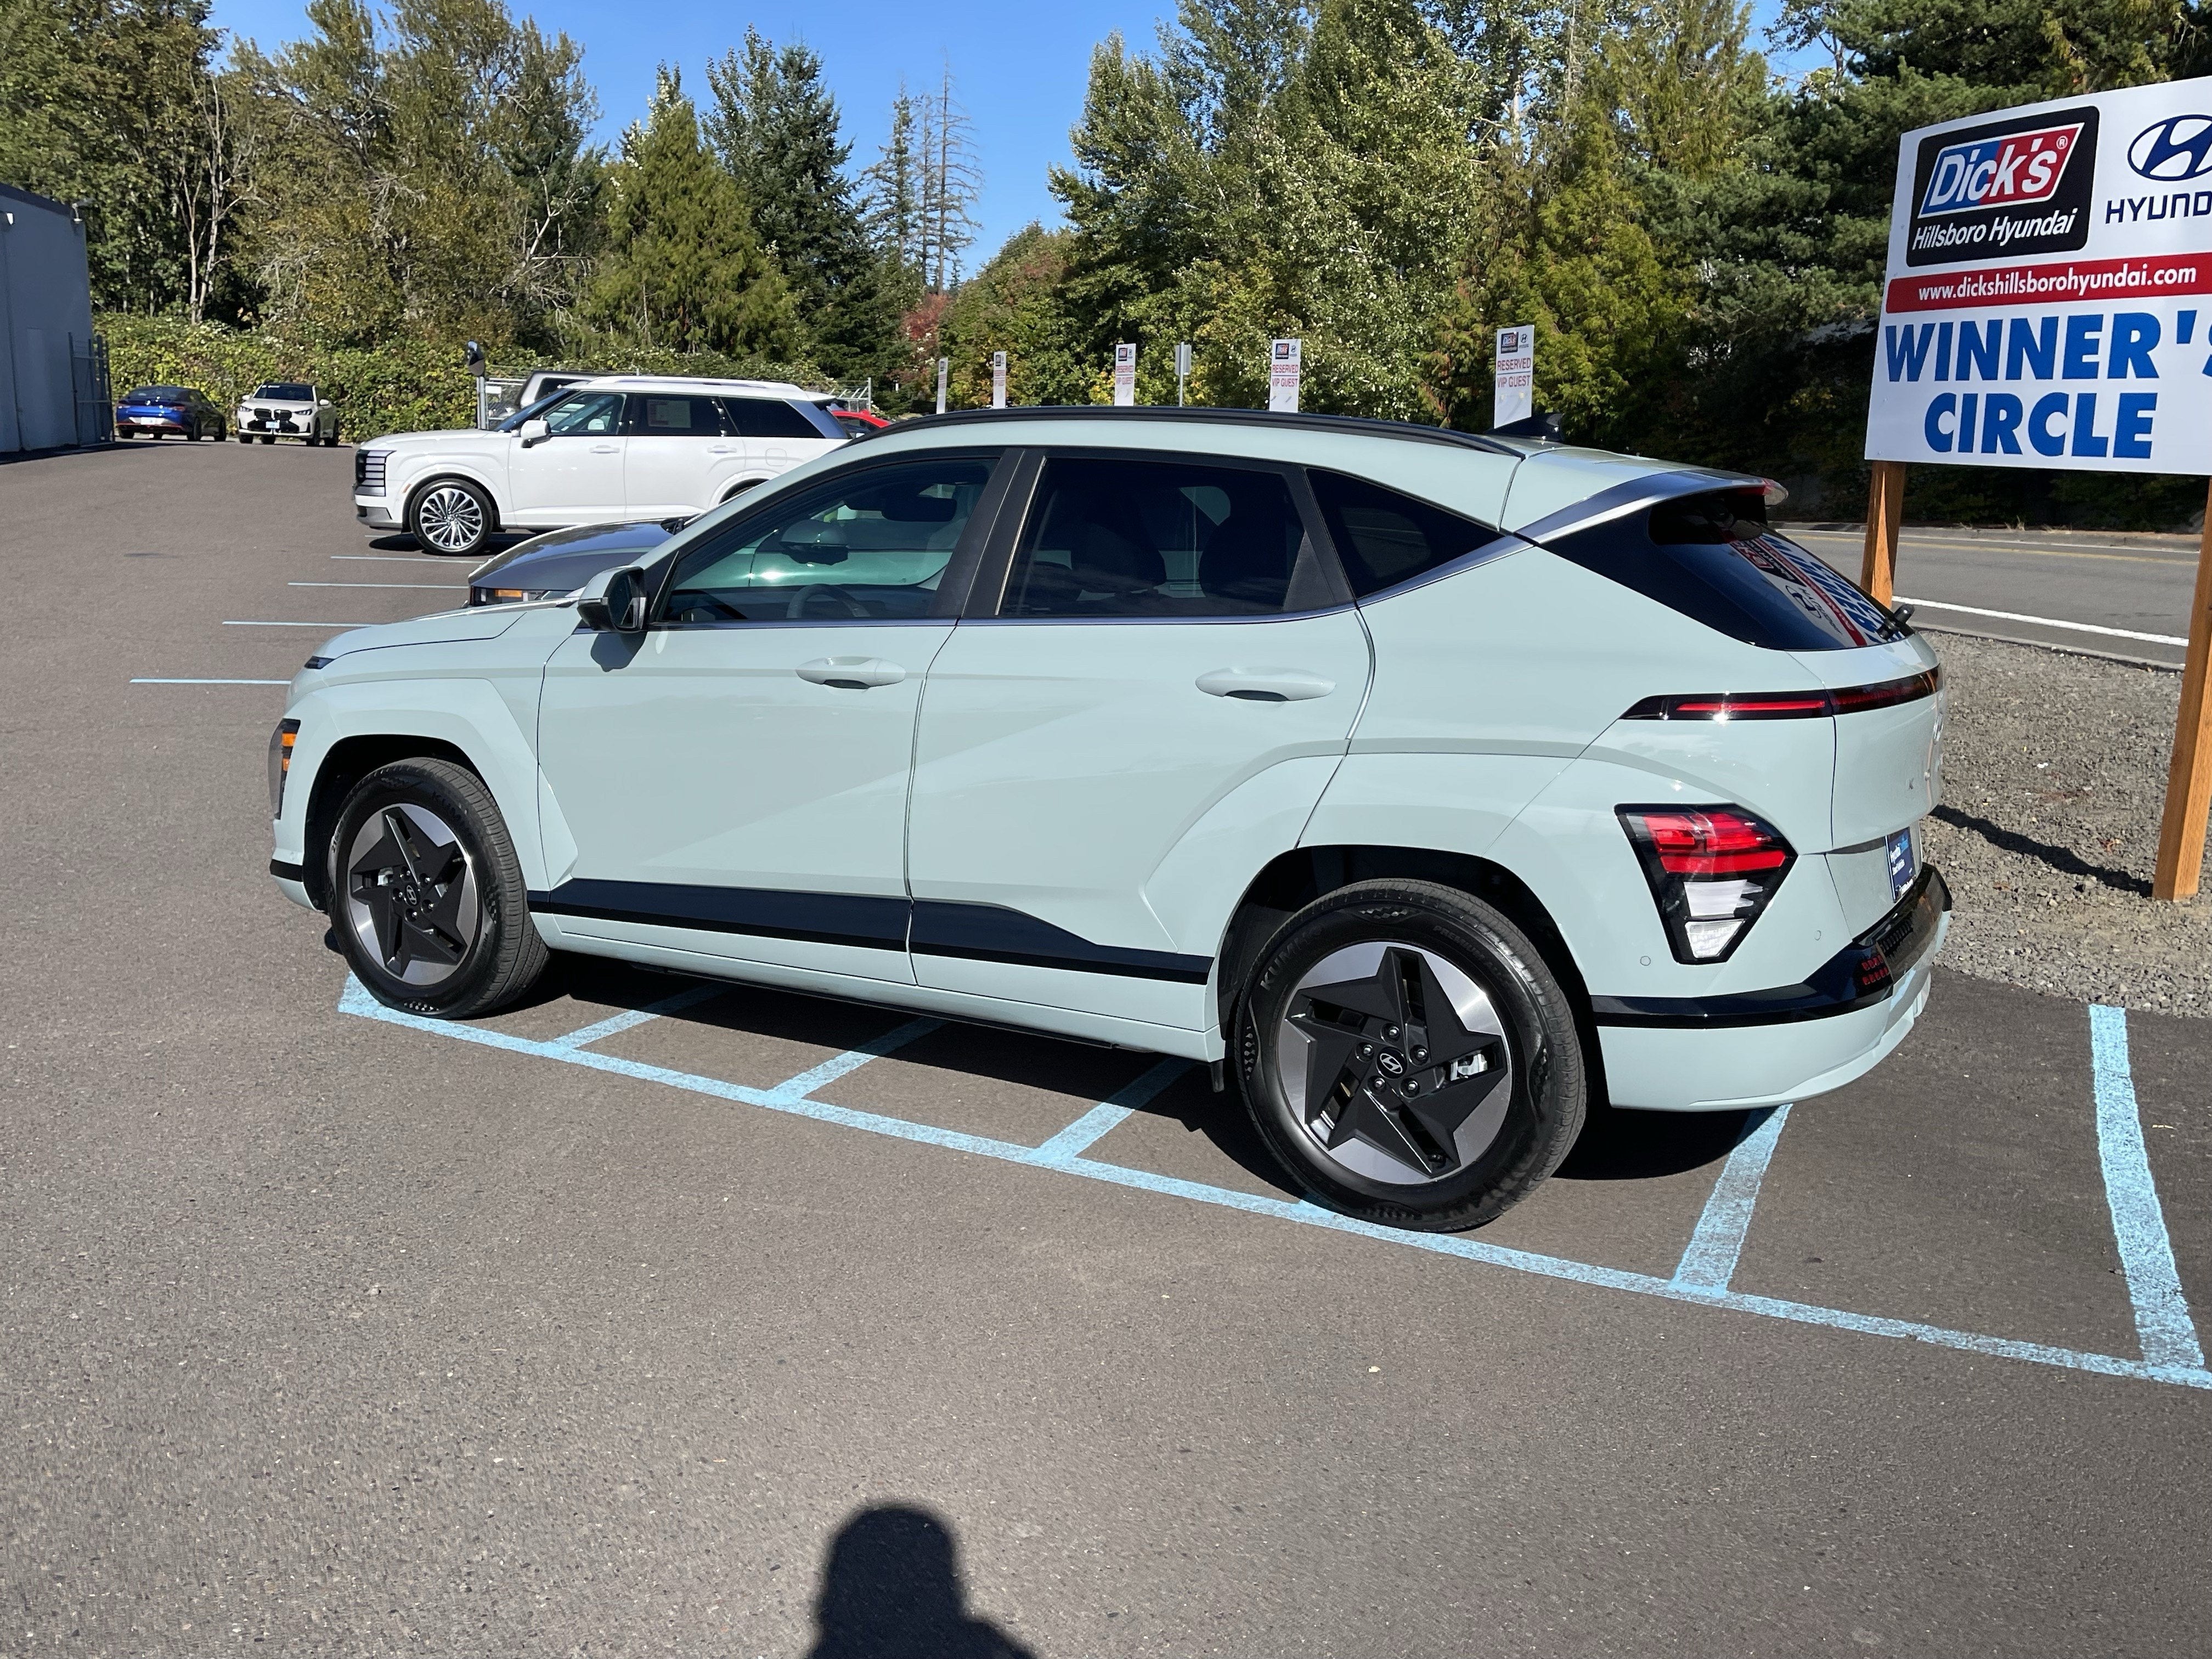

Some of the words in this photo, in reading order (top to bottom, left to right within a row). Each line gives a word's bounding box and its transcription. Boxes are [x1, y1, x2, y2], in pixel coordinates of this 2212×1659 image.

[1912, 222, 1986, 250] Hillsboro
[1988, 207, 2078, 247] Hyundai
[1918, 263, 2197, 301] www.dickshillsborohyundai.com
[1272, 364, 1299, 373] RESERVED
[1497, 357, 1531, 371] RESERVED
[1280, 378, 1298, 387] GUEST
[1497, 376, 1507, 388] VIP
[1509, 375, 1531, 387] GUEST
[1925, 392, 2158, 459] CIRCLE
